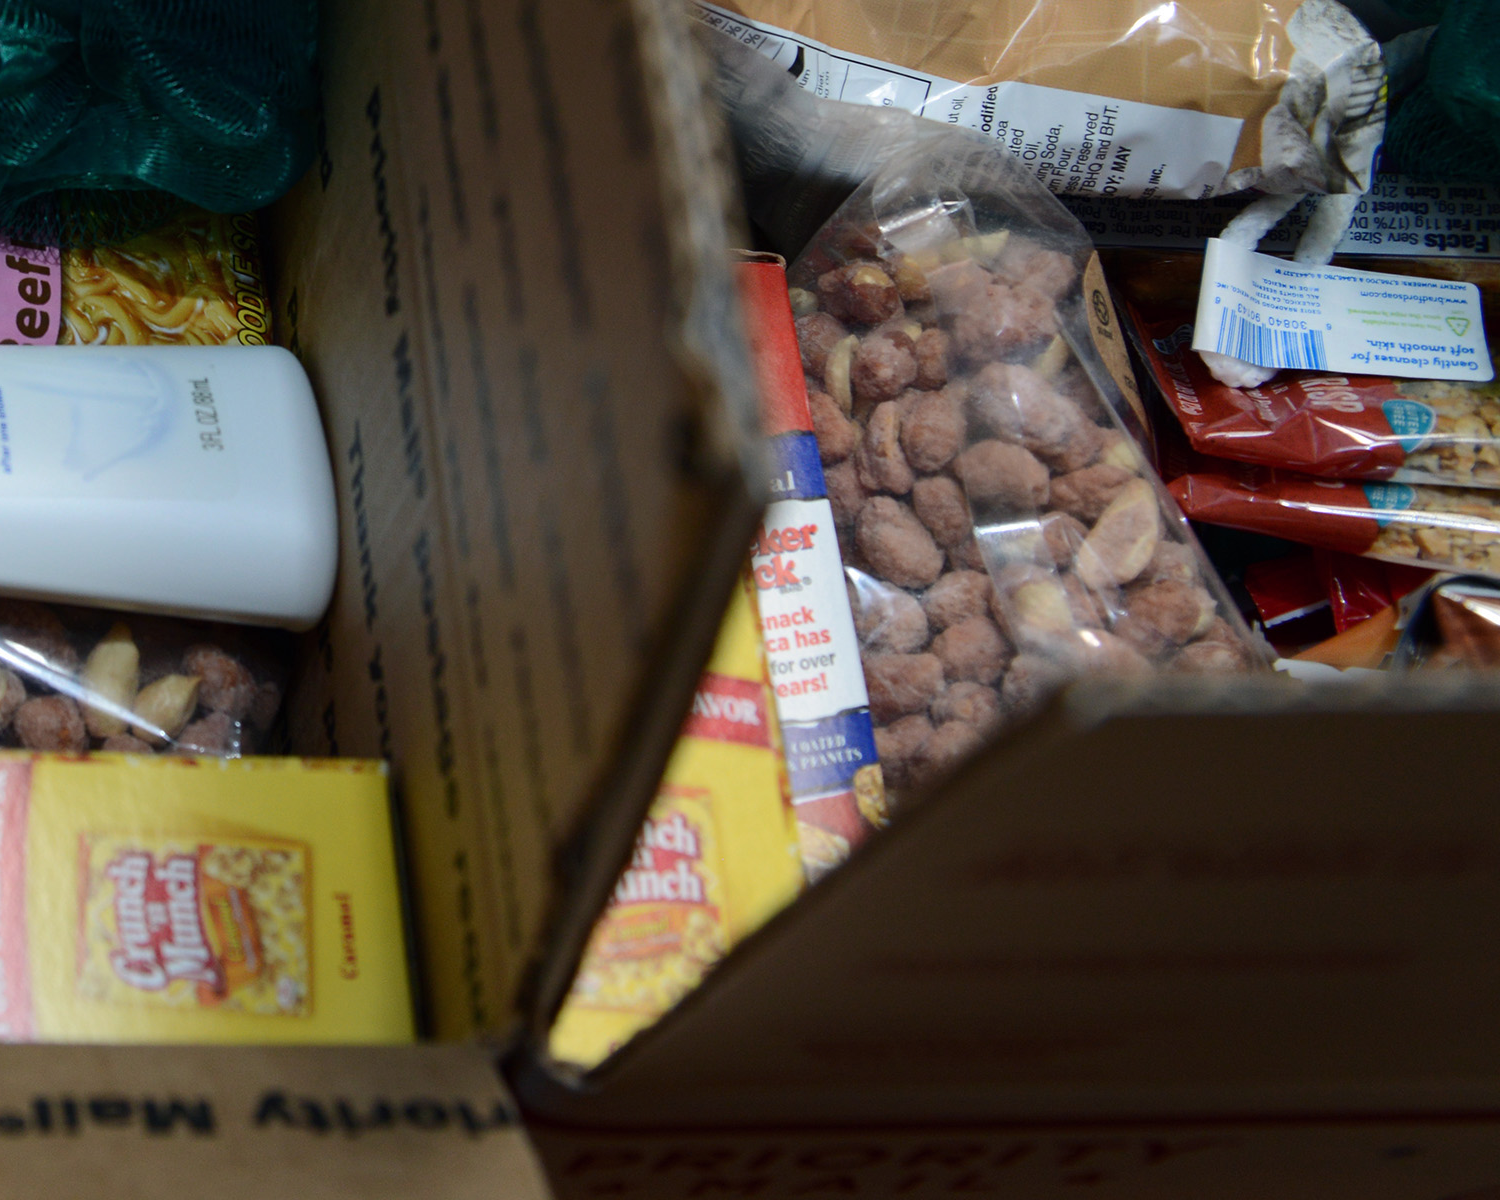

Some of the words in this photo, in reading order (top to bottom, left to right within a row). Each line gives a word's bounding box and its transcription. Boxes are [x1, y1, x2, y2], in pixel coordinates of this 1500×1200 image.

[1070, 111, 1099, 174] Preserved
[1404, 185, 1440, 198] Carb
[1349, 230, 1384, 244] Size:
[1390, 232, 1419, 245] Serv
[1424, 234, 1490, 253] Facts
[1399, 343, 1447, 354] smooth
[1377, 353, 1430, 368] cleanses
[1433, 357, 1479, 371] Gently
[794, 629, 832, 650] has
[799, 651, 837, 673] over
